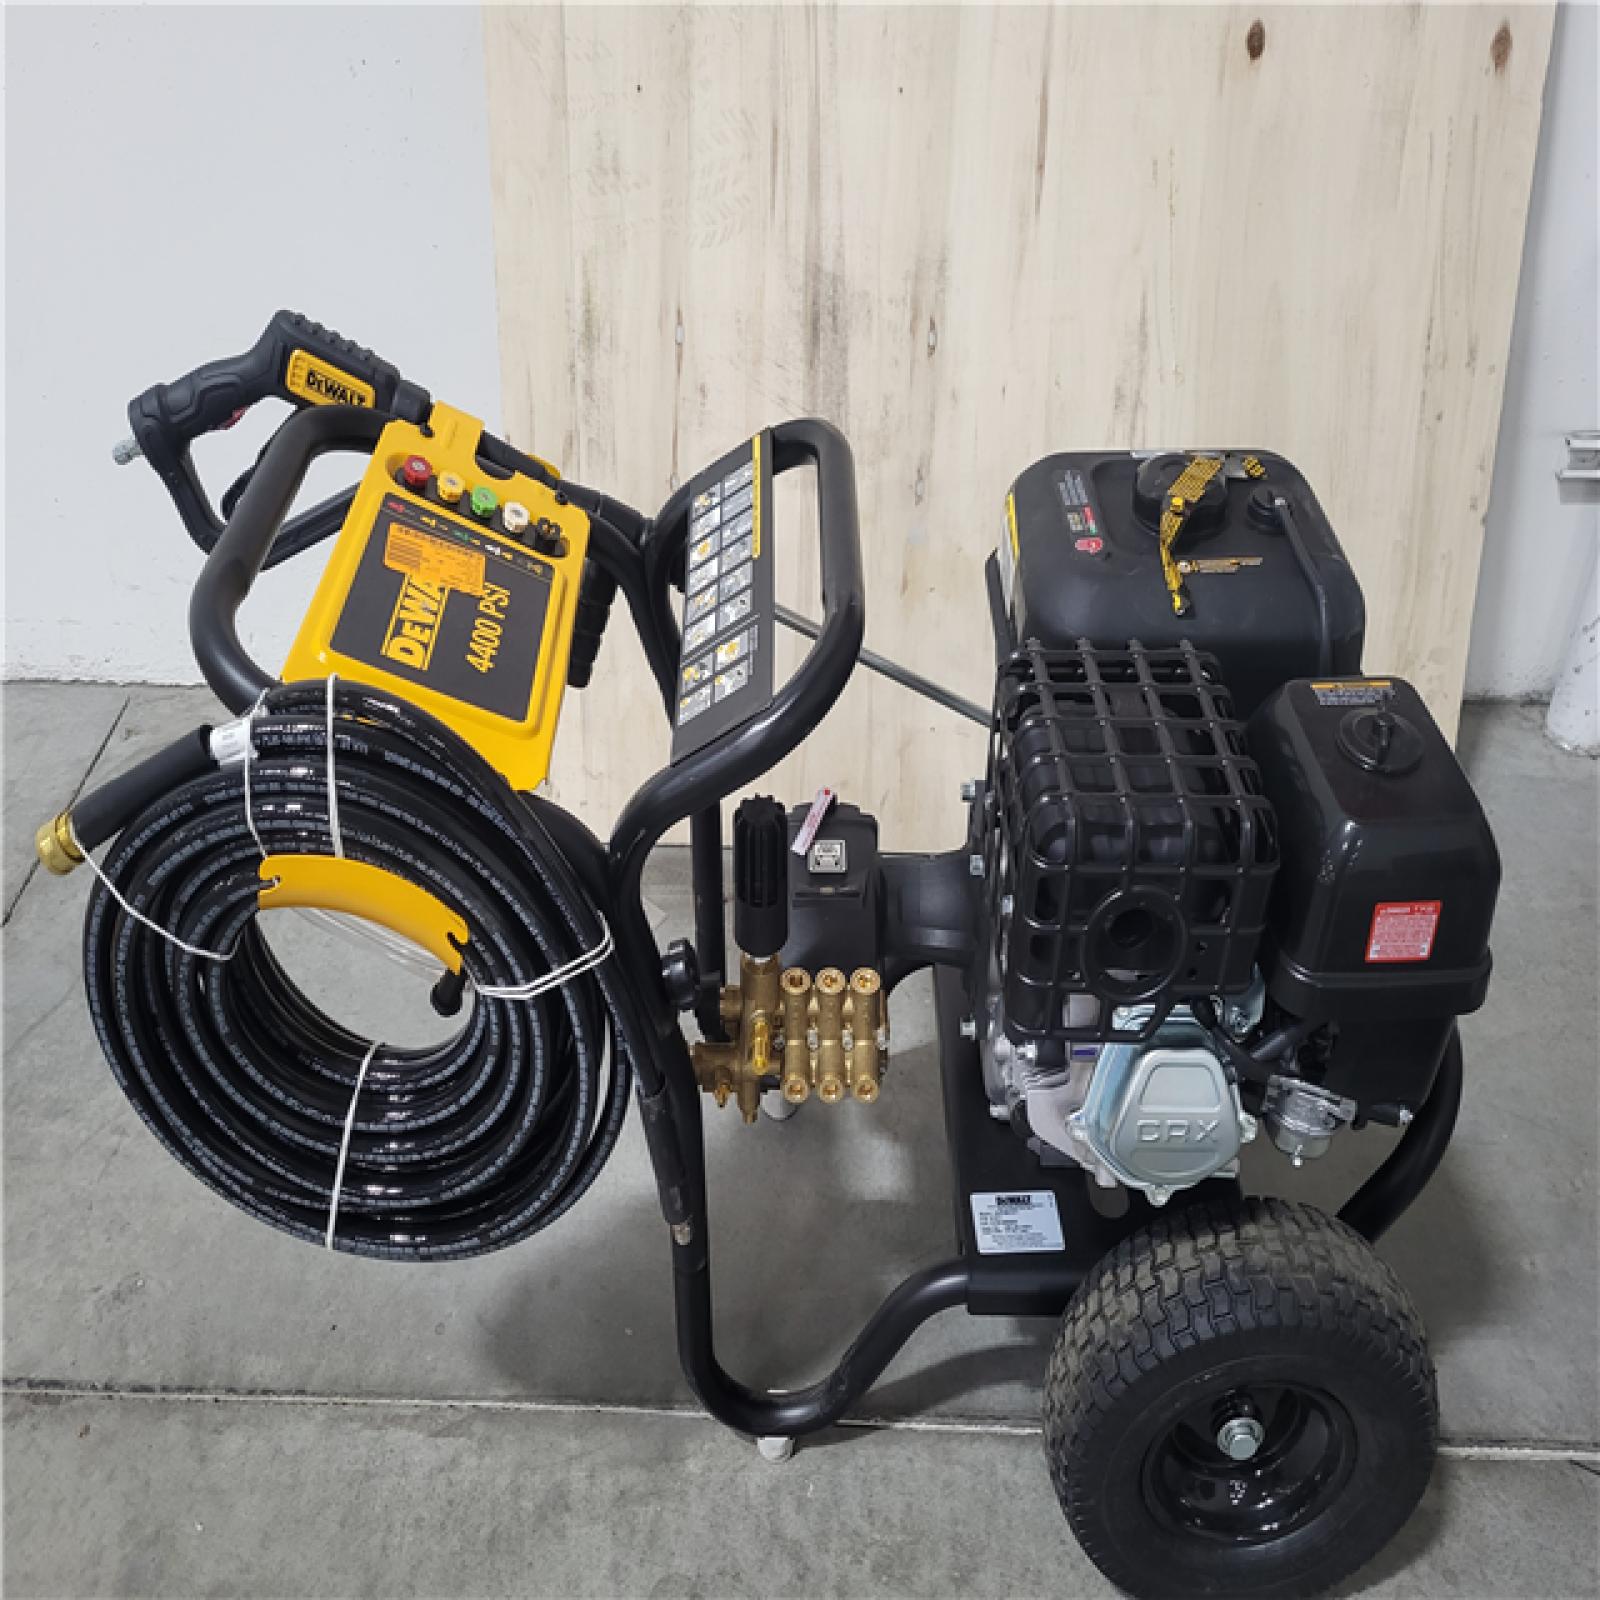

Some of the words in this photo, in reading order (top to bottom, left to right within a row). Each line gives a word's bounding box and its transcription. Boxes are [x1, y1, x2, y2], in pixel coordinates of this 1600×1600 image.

[386, 574, 445, 670] DEWA
[478, 581, 511, 620] PSI
[465, 618, 504, 673] 4400
